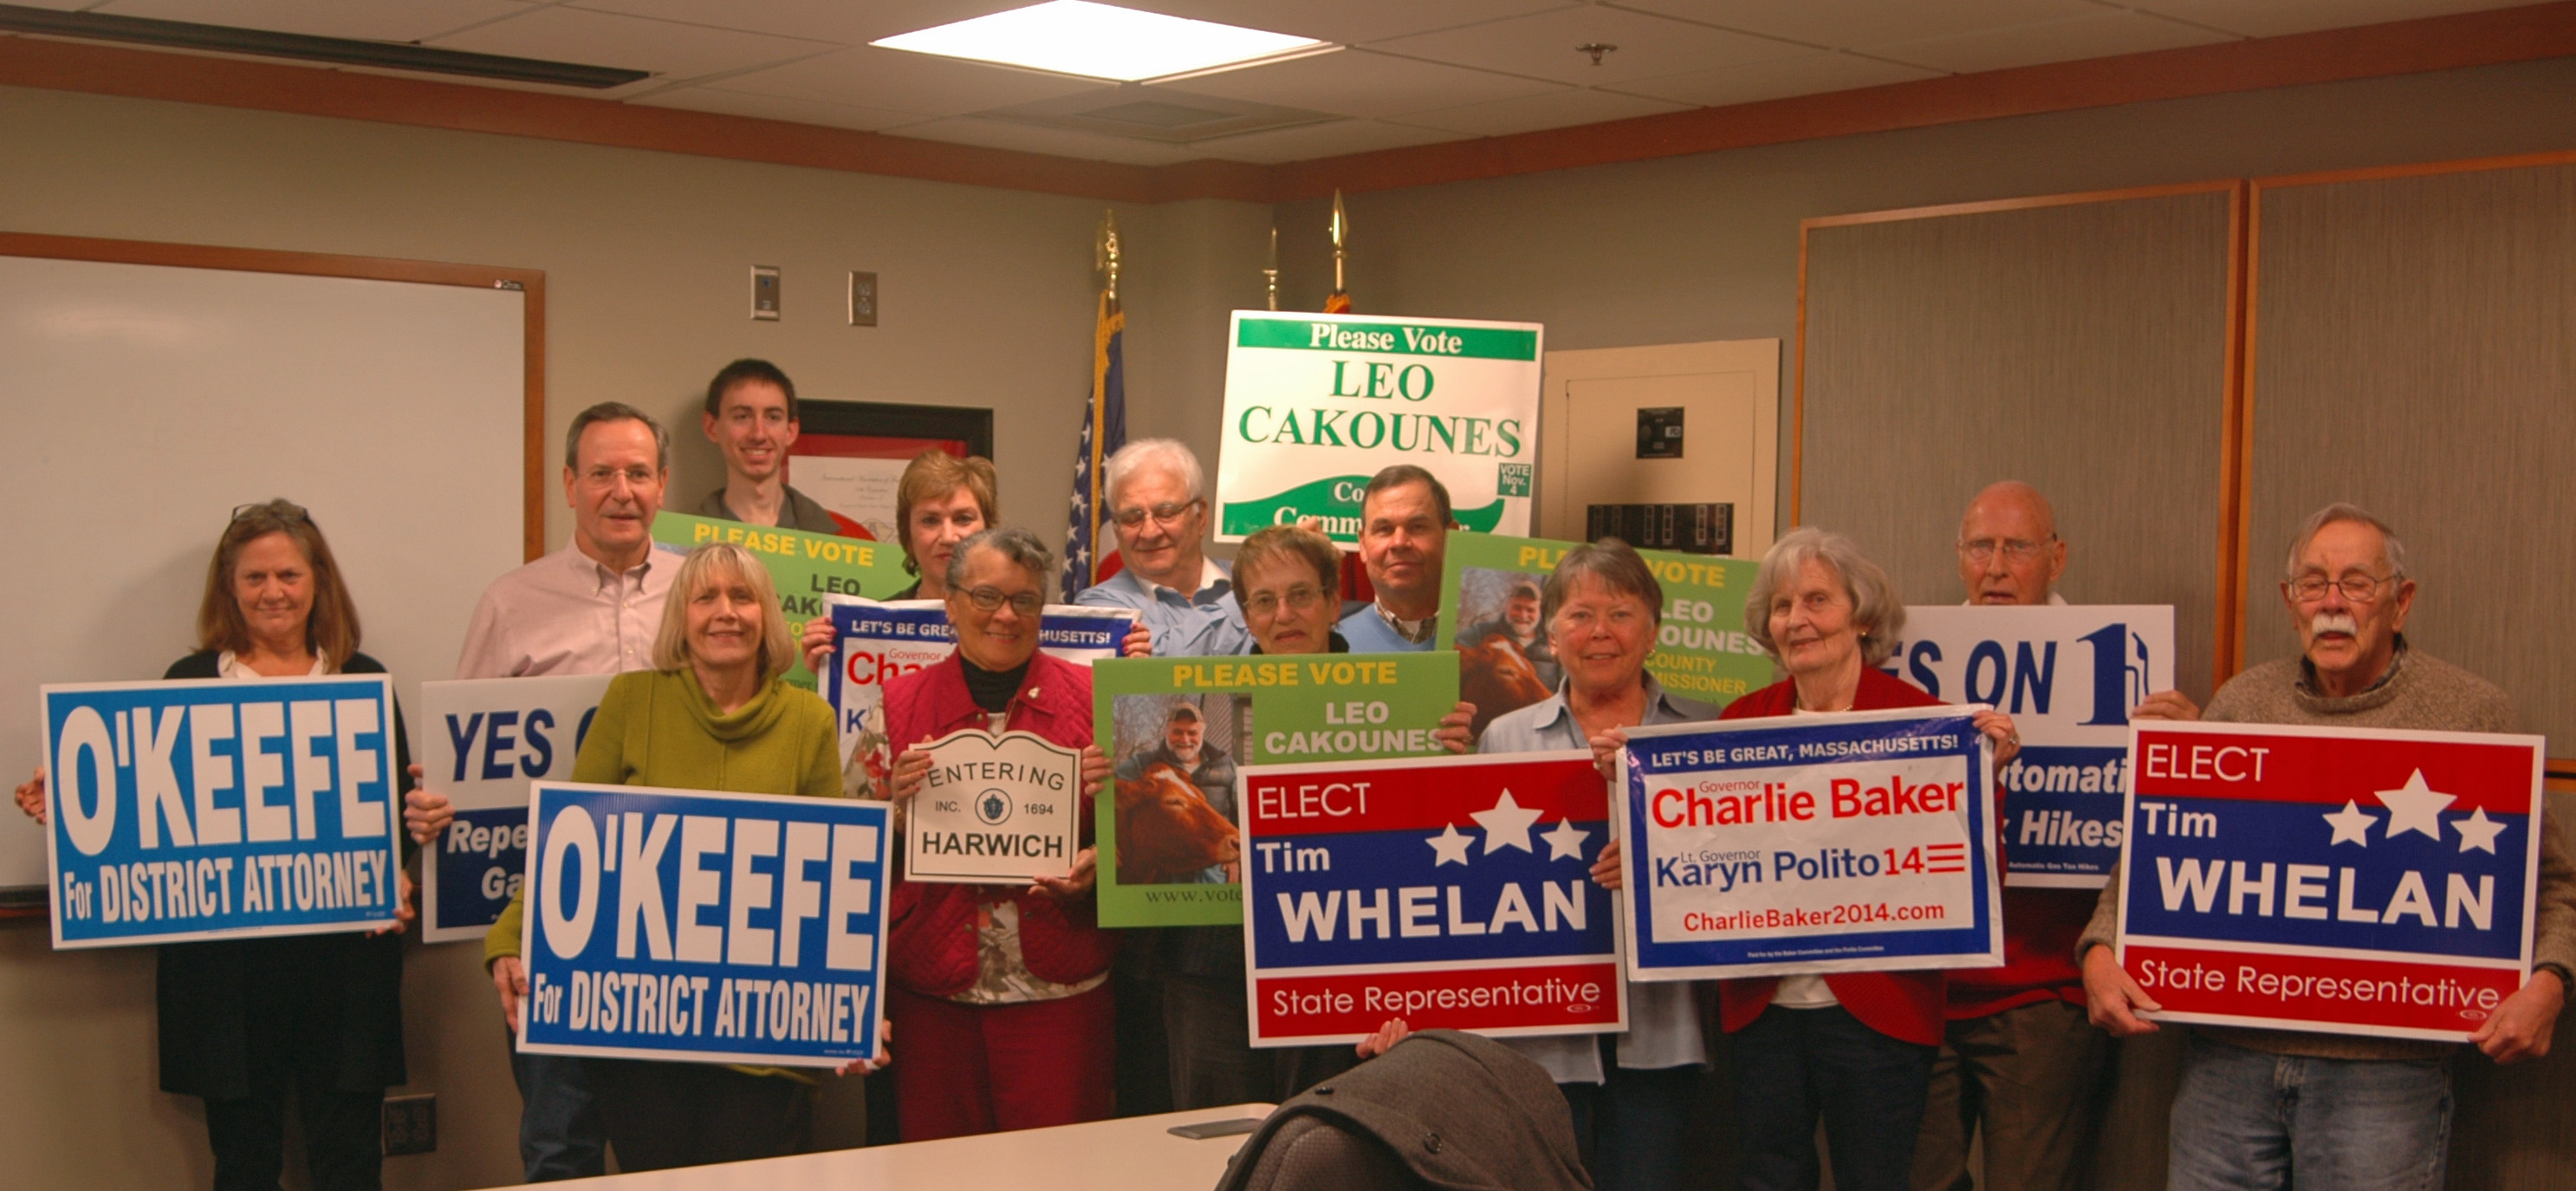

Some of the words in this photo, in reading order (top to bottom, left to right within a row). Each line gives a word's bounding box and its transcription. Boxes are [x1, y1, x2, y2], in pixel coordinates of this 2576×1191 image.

[1309, 323, 1395, 352] Please
[1403, 327, 1463, 355] Vote
[1330, 361, 1434, 401] LEO
[1238, 406, 1522, 458] CAKOUNES
[1501, 464, 1530, 476] VOTE
[1509, 485, 1517, 494] 4
[804, 538, 874, 568] VOTE
[811, 573, 861, 596] LEO
[1645, 558, 1726, 588] VOTE
[852, 620, 892, 634] LET'S
[896, 622, 915, 635] BE
[1039, 629, 1111, 644] HUSETTS!
[1658, 625, 1764, 656] OUNES
[889, 648, 941, 660] Governor
[1173, 663, 1298, 687] PLEASE
[1308, 661, 1398, 685] VOTE
[1964, 640, 2058, 714] ON
[1326, 701, 1389, 725] LEO
[445, 707, 555, 782] YES
[1264, 729, 1445, 755] CAKOUNES
[1651, 750, 1698, 768] LET'S
[1703, 748, 1726, 765] BE
[1730, 744, 1794, 763] GREAT,
[1799, 734, 1959, 758] MASSACHUSETTS!
[58, 699, 386, 856] O'KEEFE
[927, 762, 1065, 791] ENTERING
[2146, 744, 2269, 782] ELECT
[1257, 782, 1371, 819] ELECT
[1651, 783, 1815, 828] Charlie
[1831, 775, 1963, 819] Baker
[1699, 780, 1761, 794] Governor
[935, 801, 961, 812] INC.
[1023, 804, 1054, 815] 1694
[2139, 802, 2218, 838] Tim
[447, 820, 528, 859] Repe
[922, 831, 1062, 858] HARWICH
[2020, 810, 2123, 848] Hikes
[1256, 842, 1330, 874] Tim
[1657, 856, 1762, 892] Karyn
[1774, 848, 1880, 882] Polito
[1681, 852, 1696, 864] Lt.
[1700, 849, 1761, 862] Governor
[64, 871, 92, 920] For
[100, 856, 233, 923] DISTRICT
[243, 849, 386, 914] ATTORNEY
[540, 804, 879, 971] O'KEEFE
[2156, 856, 2495, 931] WHELAN
[1276, 880, 1586, 943] WHELAN
[1684, 902, 1945, 932] CharlieBaker2014.com
[1273, 988, 1354, 1017] State
[1365, 978, 1601, 1016] Representative
[2138, 959, 2226, 992] State
[2236, 965, 2500, 1009] Representative
[532, 973, 563, 1024] For
[569, 969, 710, 1037] DISTRICT
[714, 977, 870, 1044] ATTORNEY
